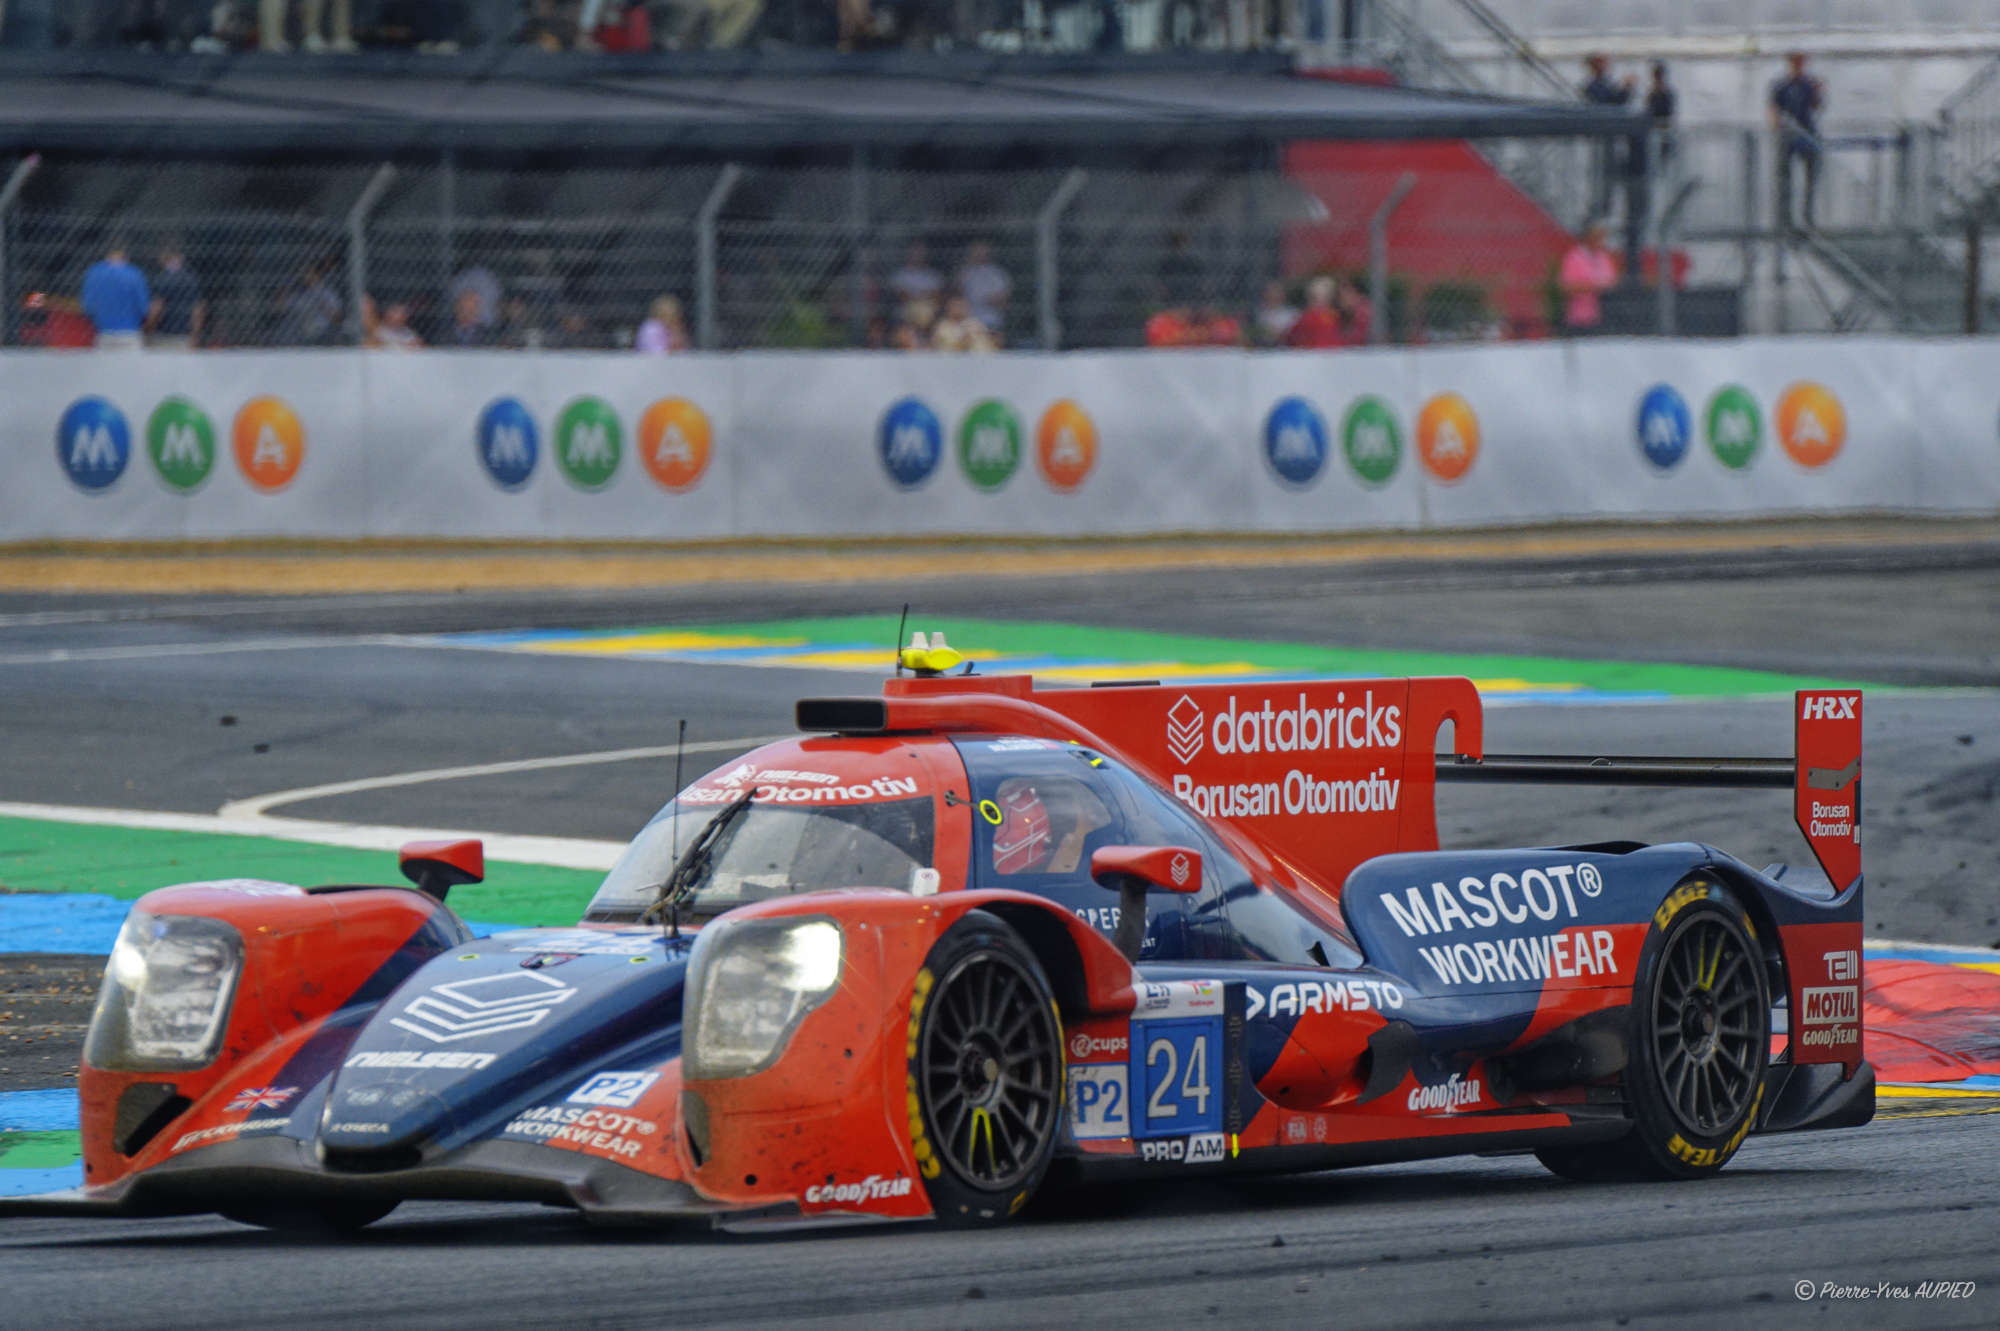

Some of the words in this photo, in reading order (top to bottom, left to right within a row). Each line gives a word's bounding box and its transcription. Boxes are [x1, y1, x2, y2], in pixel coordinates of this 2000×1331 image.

[1212, 690, 1401, 755] databricks
[1803, 696, 1858, 719] HRX
[1173, 774, 1280, 818] Borusan
[1283, 767, 1400, 816] Otomotiv
[1812, 801, 1849, 818] Borusan
[1810, 819, 1850, 837] Otomotiv
[1418, 930, 1618, 985] WORKWEAR
[1806, 992, 1855, 1018] MOTUL
[1802, 1023, 1858, 1048] GOODYEAR
[582, 1077, 642, 1099] P2
[1147, 1036, 1210, 1118] 24
[1076, 1080, 1123, 1123] P2
[1407, 1073, 1481, 1112] GOODYEAR
[504, 1121, 642, 1158] WORKWEAR
[1141, 1140, 1184, 1161] PRO
[1193, 1138, 1222, 1158] AM
[806, 1174, 912, 1204] GOODYEAR
